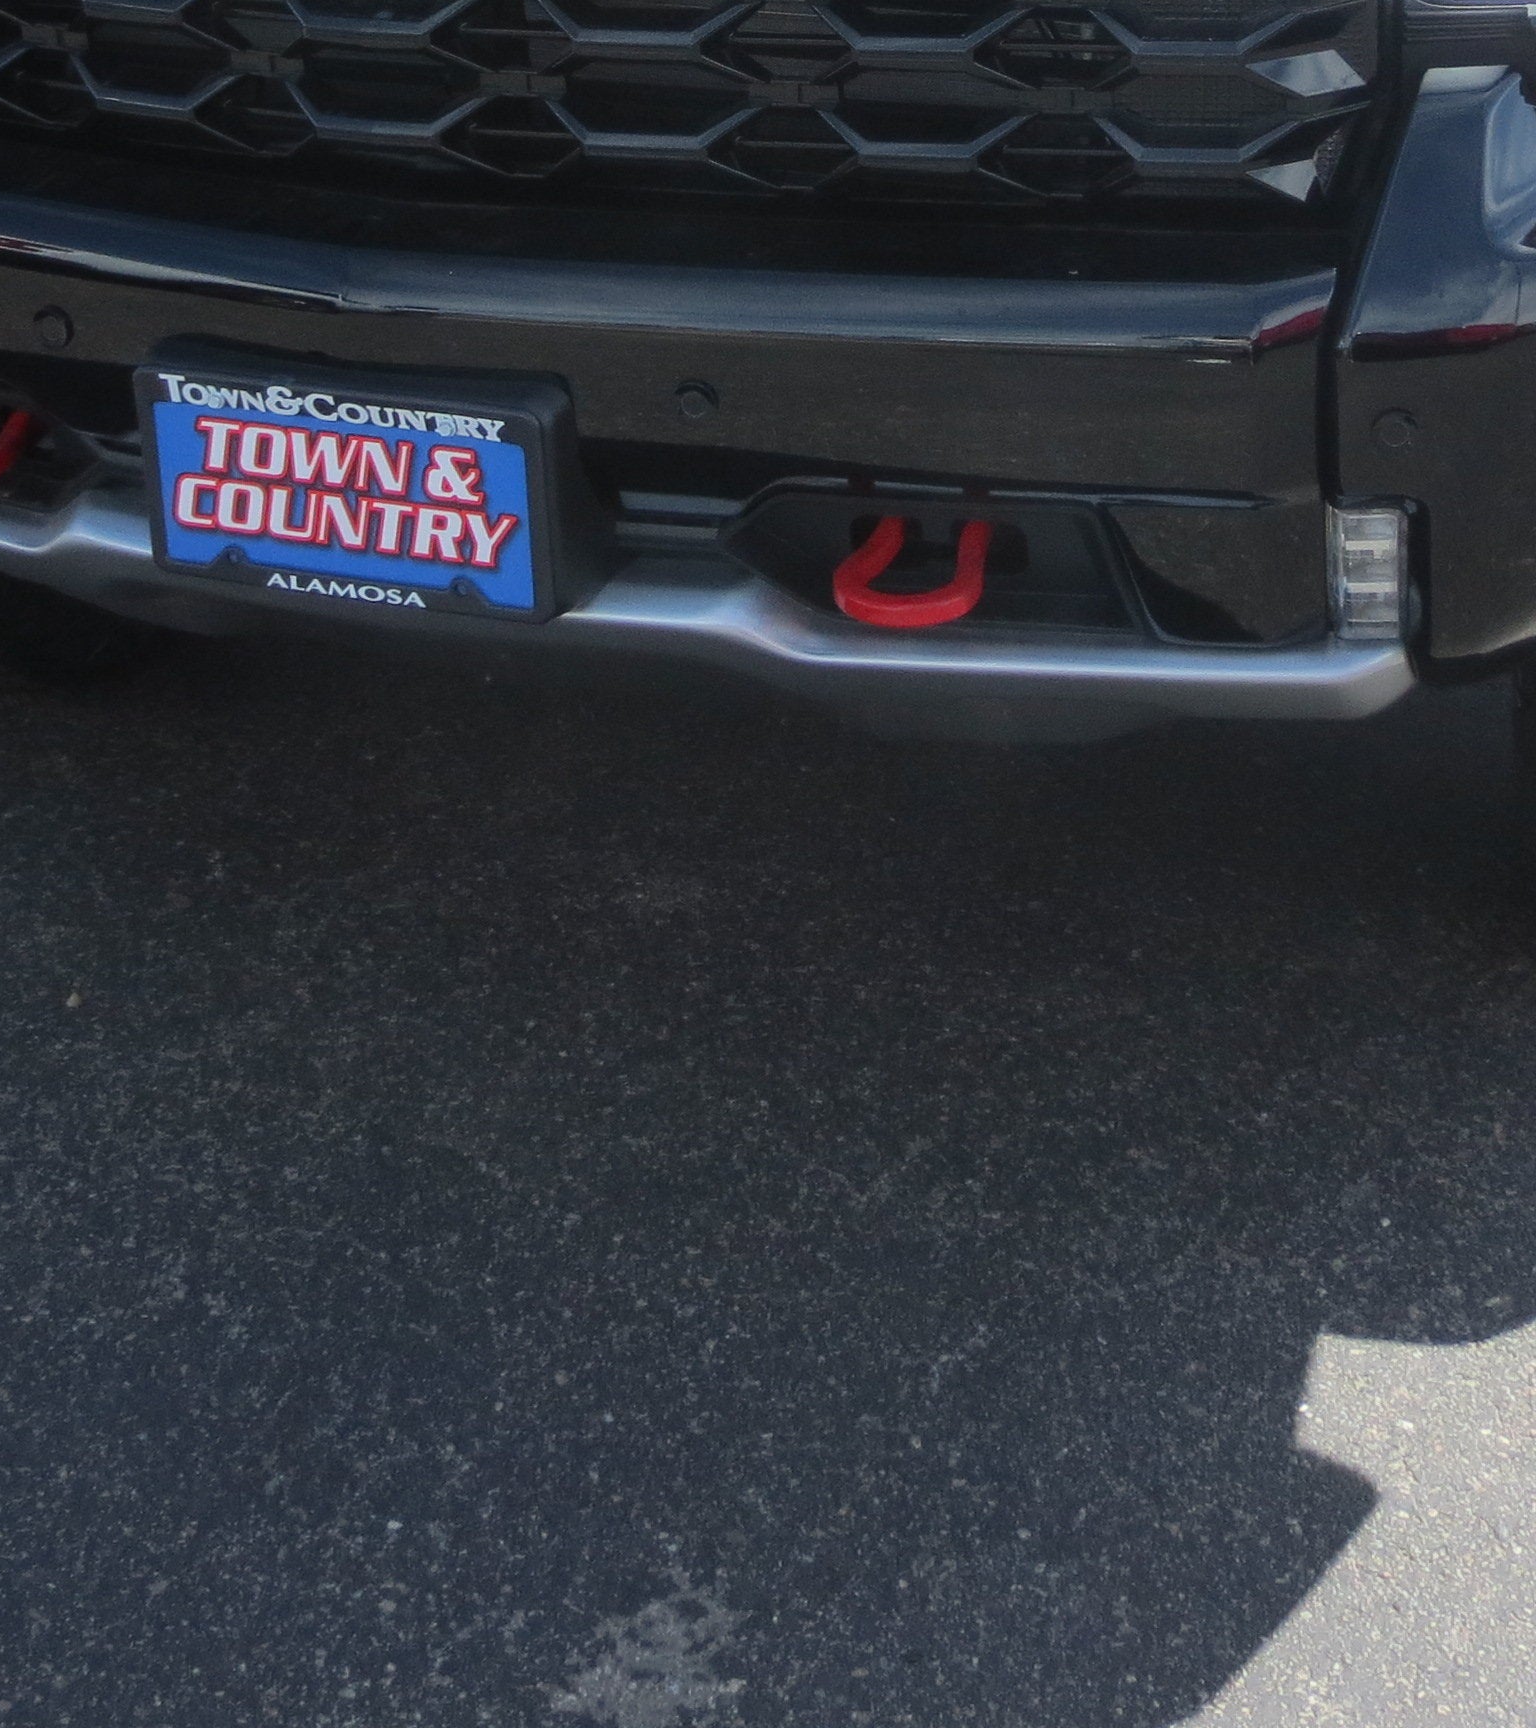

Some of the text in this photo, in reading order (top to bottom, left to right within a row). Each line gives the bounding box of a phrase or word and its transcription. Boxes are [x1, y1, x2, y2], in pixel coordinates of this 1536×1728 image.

[196, 416, 484, 505] TOWN &
[173, 474, 517, 567] COUNTRY
[267, 573, 426, 608] ALAMOSA
